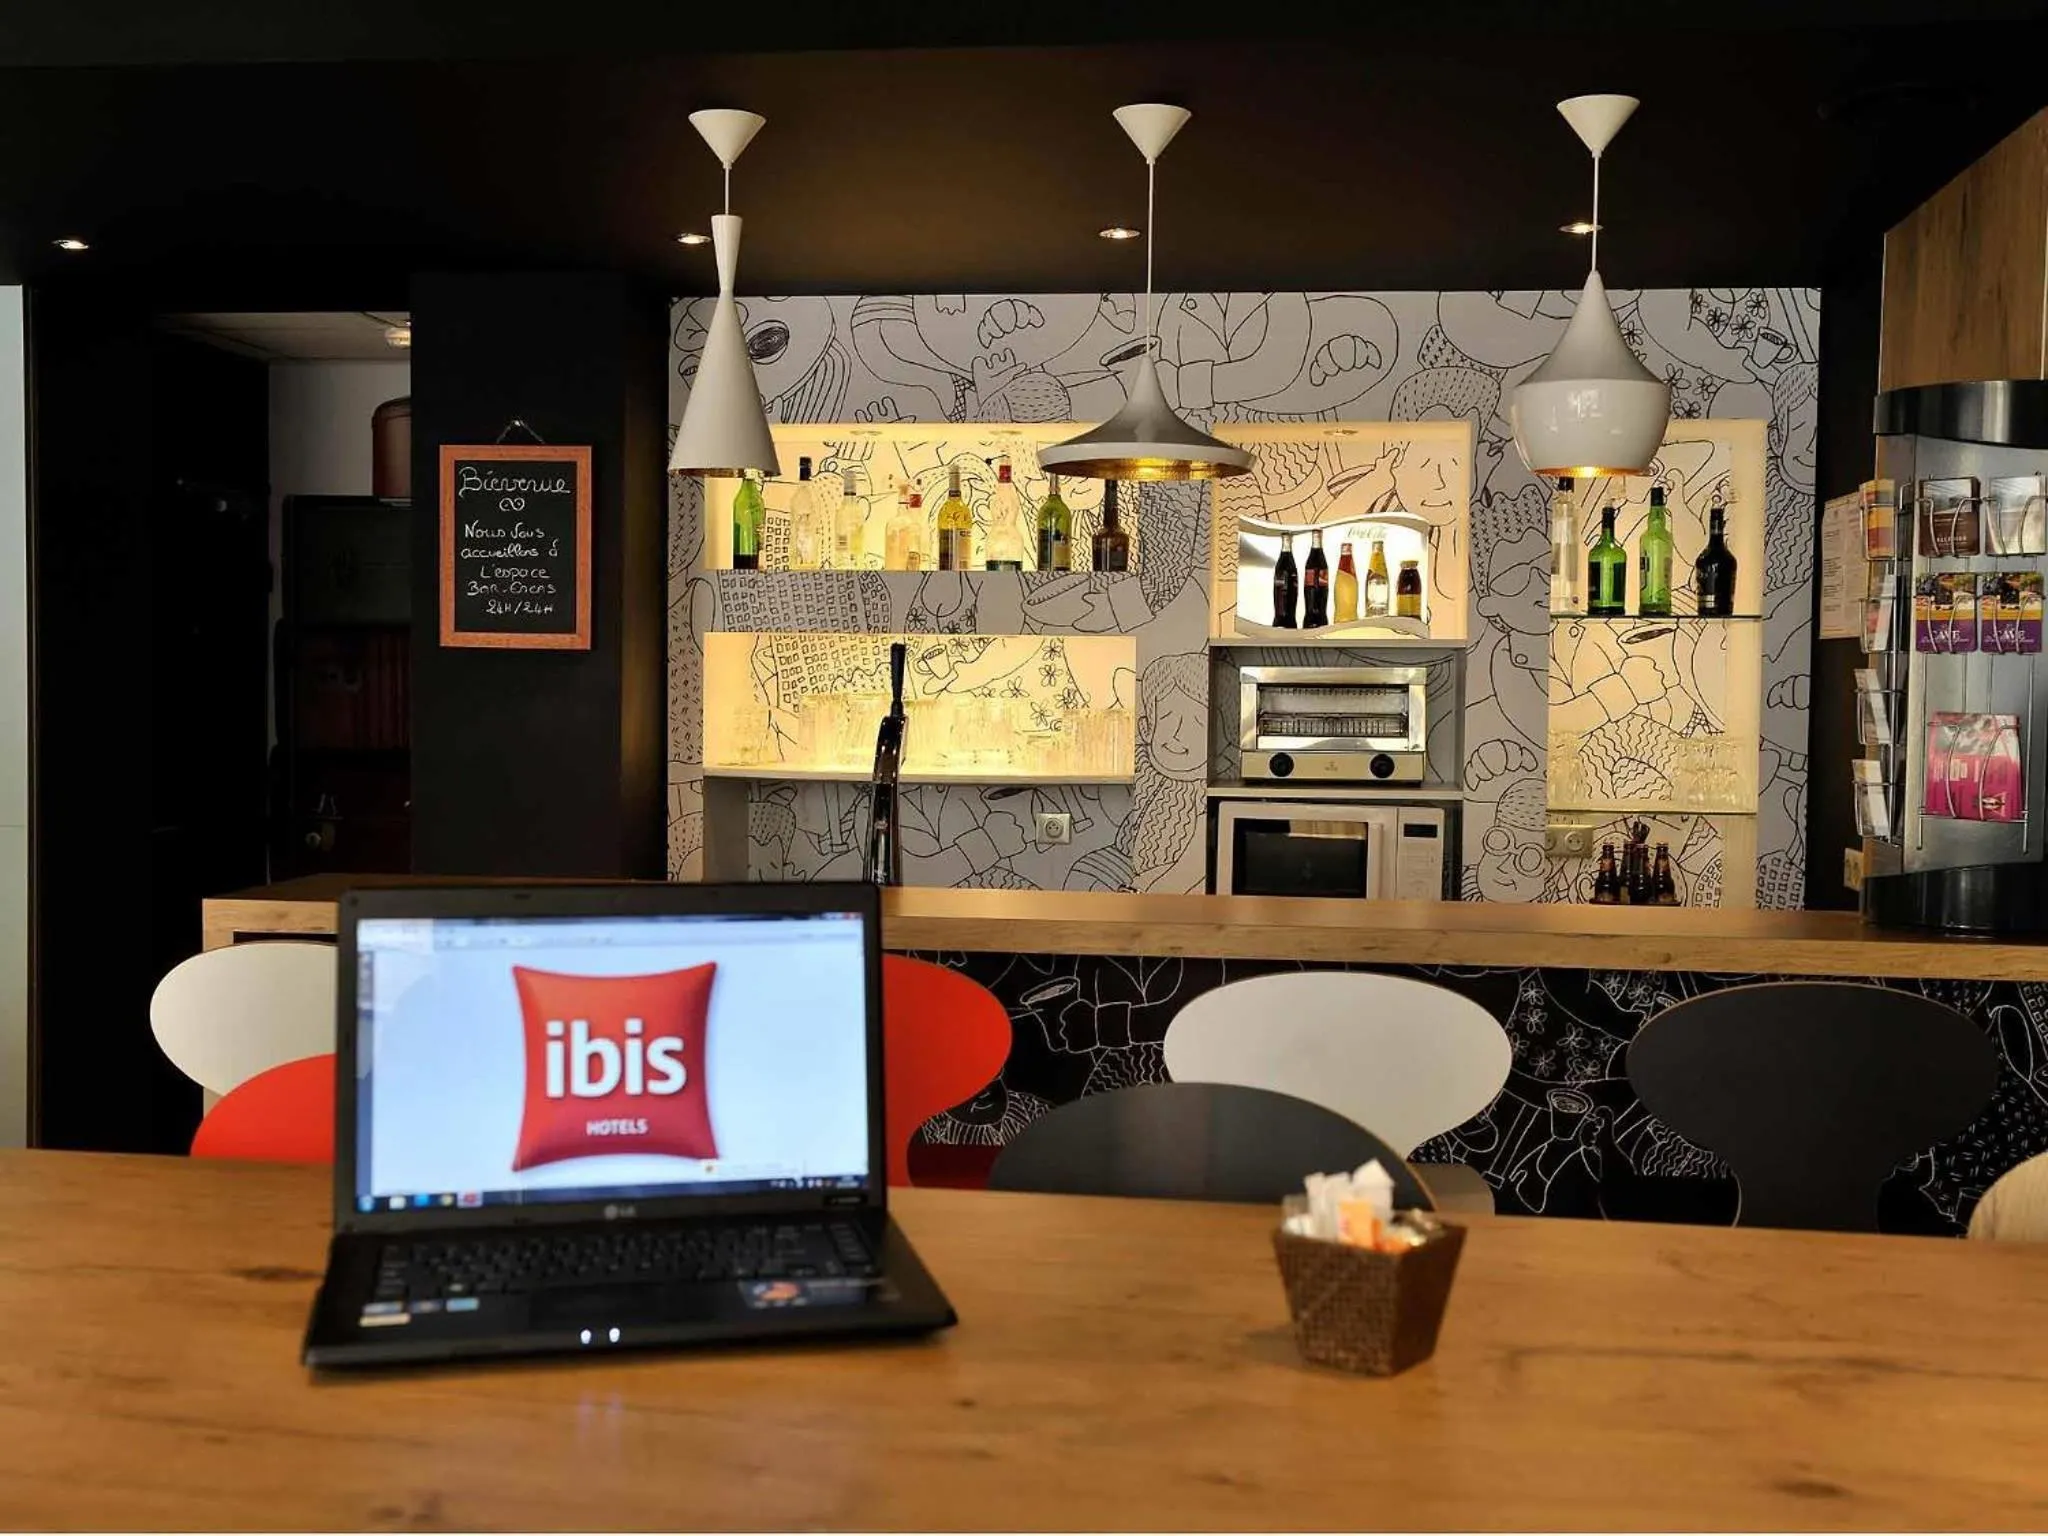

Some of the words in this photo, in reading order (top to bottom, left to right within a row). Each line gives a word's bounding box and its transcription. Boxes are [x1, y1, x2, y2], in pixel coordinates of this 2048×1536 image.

[458, 467, 571, 498] Bienvenue
[464, 520, 506, 539] Nous
[546, 1018, 687, 1098] ibis
[586, 1118, 649, 1137] HOTELS
